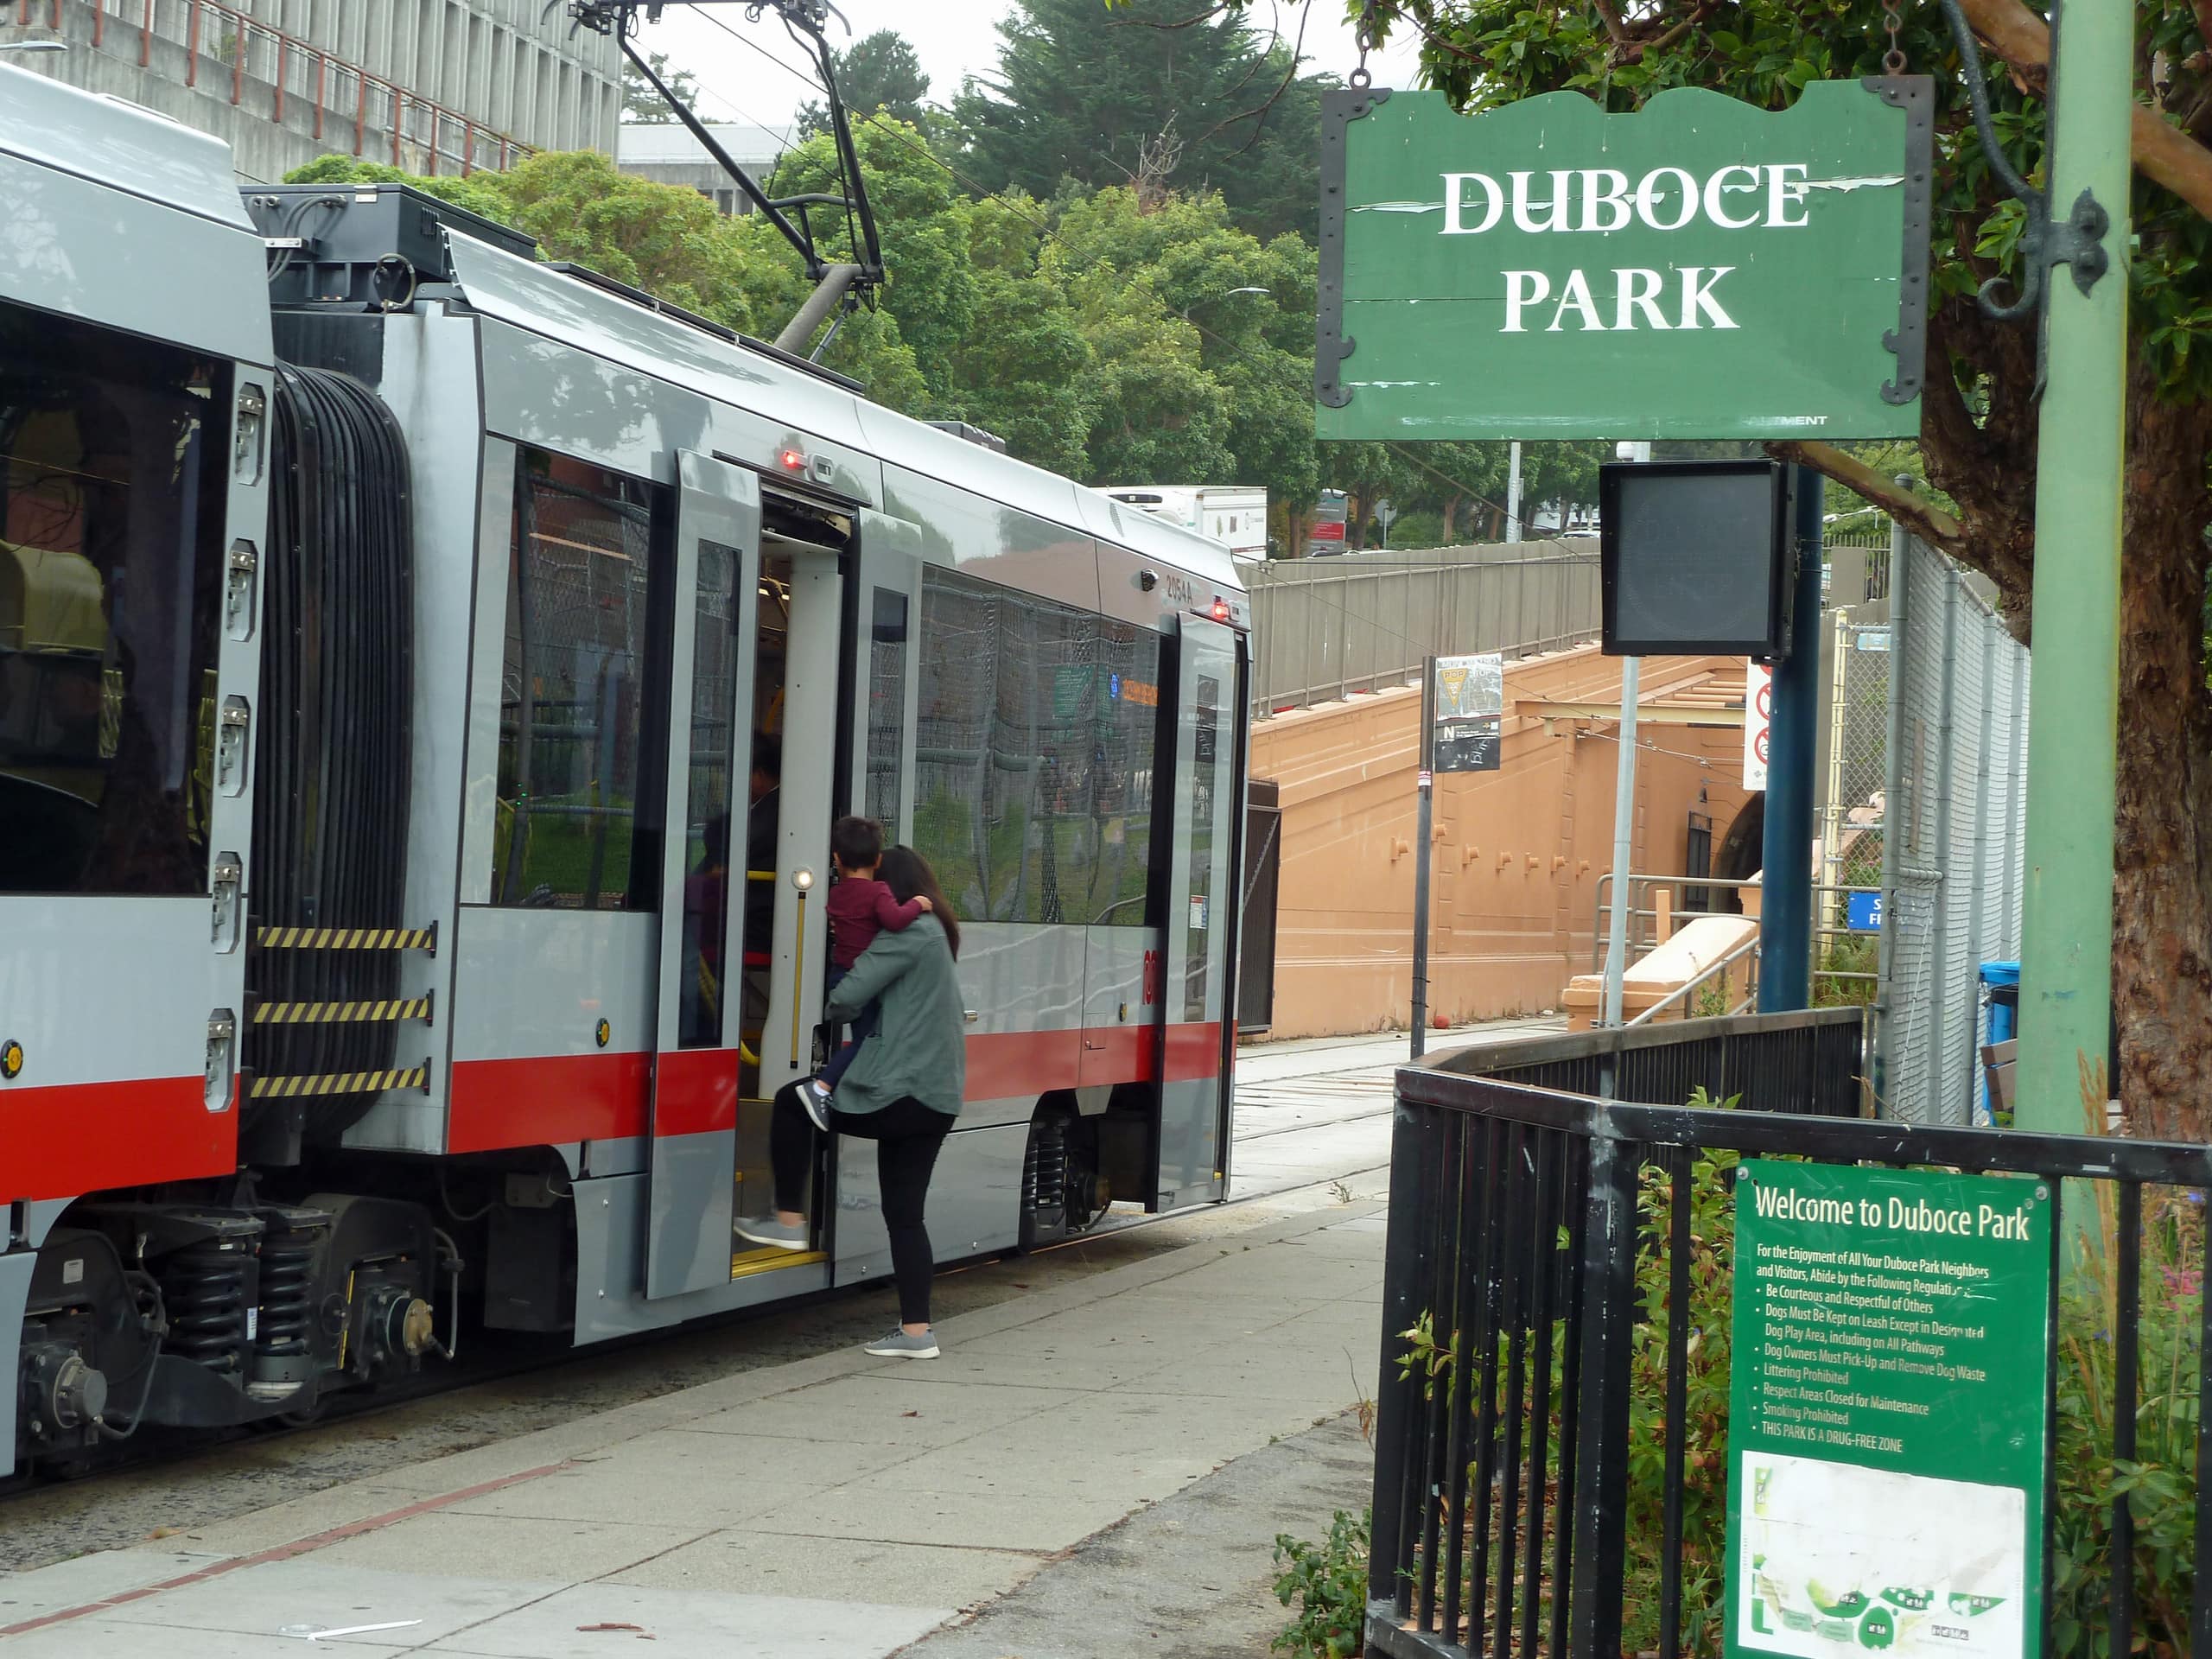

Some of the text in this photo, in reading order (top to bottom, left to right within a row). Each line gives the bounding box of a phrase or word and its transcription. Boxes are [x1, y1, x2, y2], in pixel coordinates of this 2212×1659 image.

[1438, 163, 1809, 235] DUBOCE
[1500, 267, 1740, 333] PARK
[1166, 575, 1193, 606] 2054A
[1444, 725, 1455, 739] N
[1756, 1185, 2030, 1241] Welcome to Duboce Park
[1758, 1243, 1989, 1279] For the Enjoyment of All Your Duboce Park Neighbors
[1757, 1264, 1773, 1277] and
[1774, 1264, 1808, 1282] Visitors,
[1810, 1268, 1836, 1283] Abide
[1838, 1271, 1848, 1287] by
[1851, 1273, 1866, 1287] the
[1867, 1274, 1911, 1294] Following
[1766, 1283, 1933, 1313] Be Courteous and Respectful of Others
[1765, 1303, 1787, 1320] Dogs
[1789, 1306, 1811, 1320] Must
[1813, 1308, 1824, 1322] Be
[1827, 1310, 1847, 1327] Kept
[1848, 1314, 1859, 1326] on
[1862, 1313, 1887, 1329] Leash
[1890, 1317, 1919, 1335] Except
[1921, 1320, 1929, 1333] in
[1765, 1323, 1783, 1340] Dog
[1784, 1325, 1803, 1342] Play
[1805, 1327, 1827, 1344] Area,
[1873, 1338, 1885, 1349] on
[1887, 1337, 1899, 1351] All
[1901, 1338, 1944, 1358] Pathways
[1764, 1343, 1986, 1382] Dog Owners Must Pick-Up and Remove Dog Waste
[1764, 1362, 1849, 1384] Littering Prohibited
[1763, 1402, 1849, 1425] Smoking Prohibited
[1764, 1382, 1929, 1415] Respect Areas Closed for Maintenance
[1762, 1421, 1904, 1452] THIS PARK IS A DRUG-FREE ZONE
